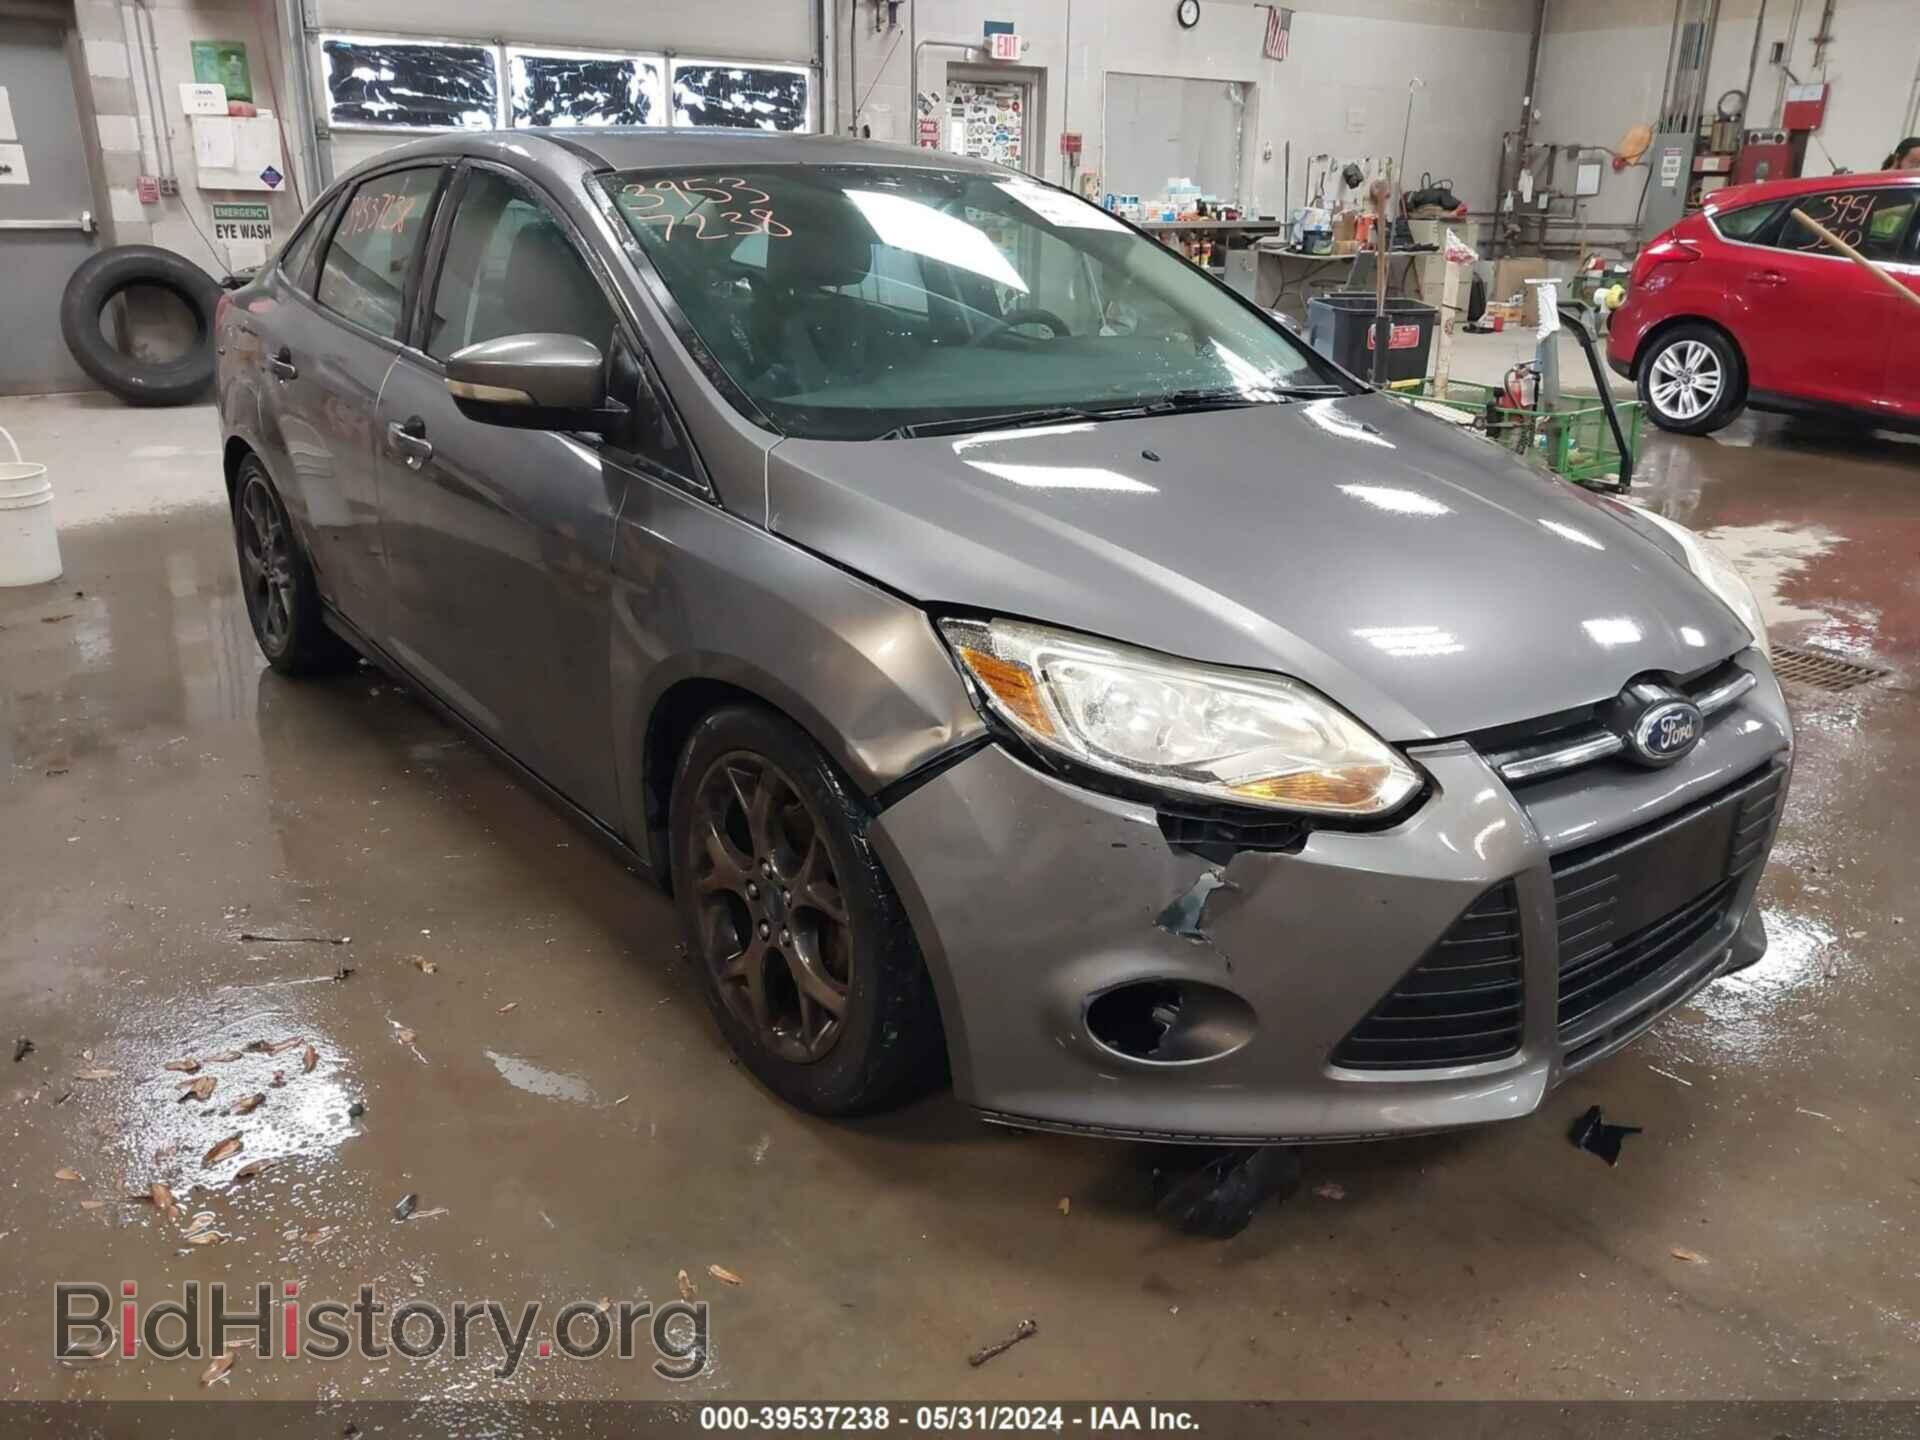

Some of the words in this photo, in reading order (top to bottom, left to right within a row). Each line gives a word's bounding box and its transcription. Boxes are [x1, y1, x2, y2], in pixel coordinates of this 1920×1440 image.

[997, 36, 1018, 57] EXIT
[622, 178, 770, 211] 3953
[215, 207, 268, 218] EMERGENCY
[636, 208, 793, 242] 7238
[216, 224, 238, 239] EYE
[240, 224, 272, 239] WASH
[1660, 712, 1696, 749] Ford
